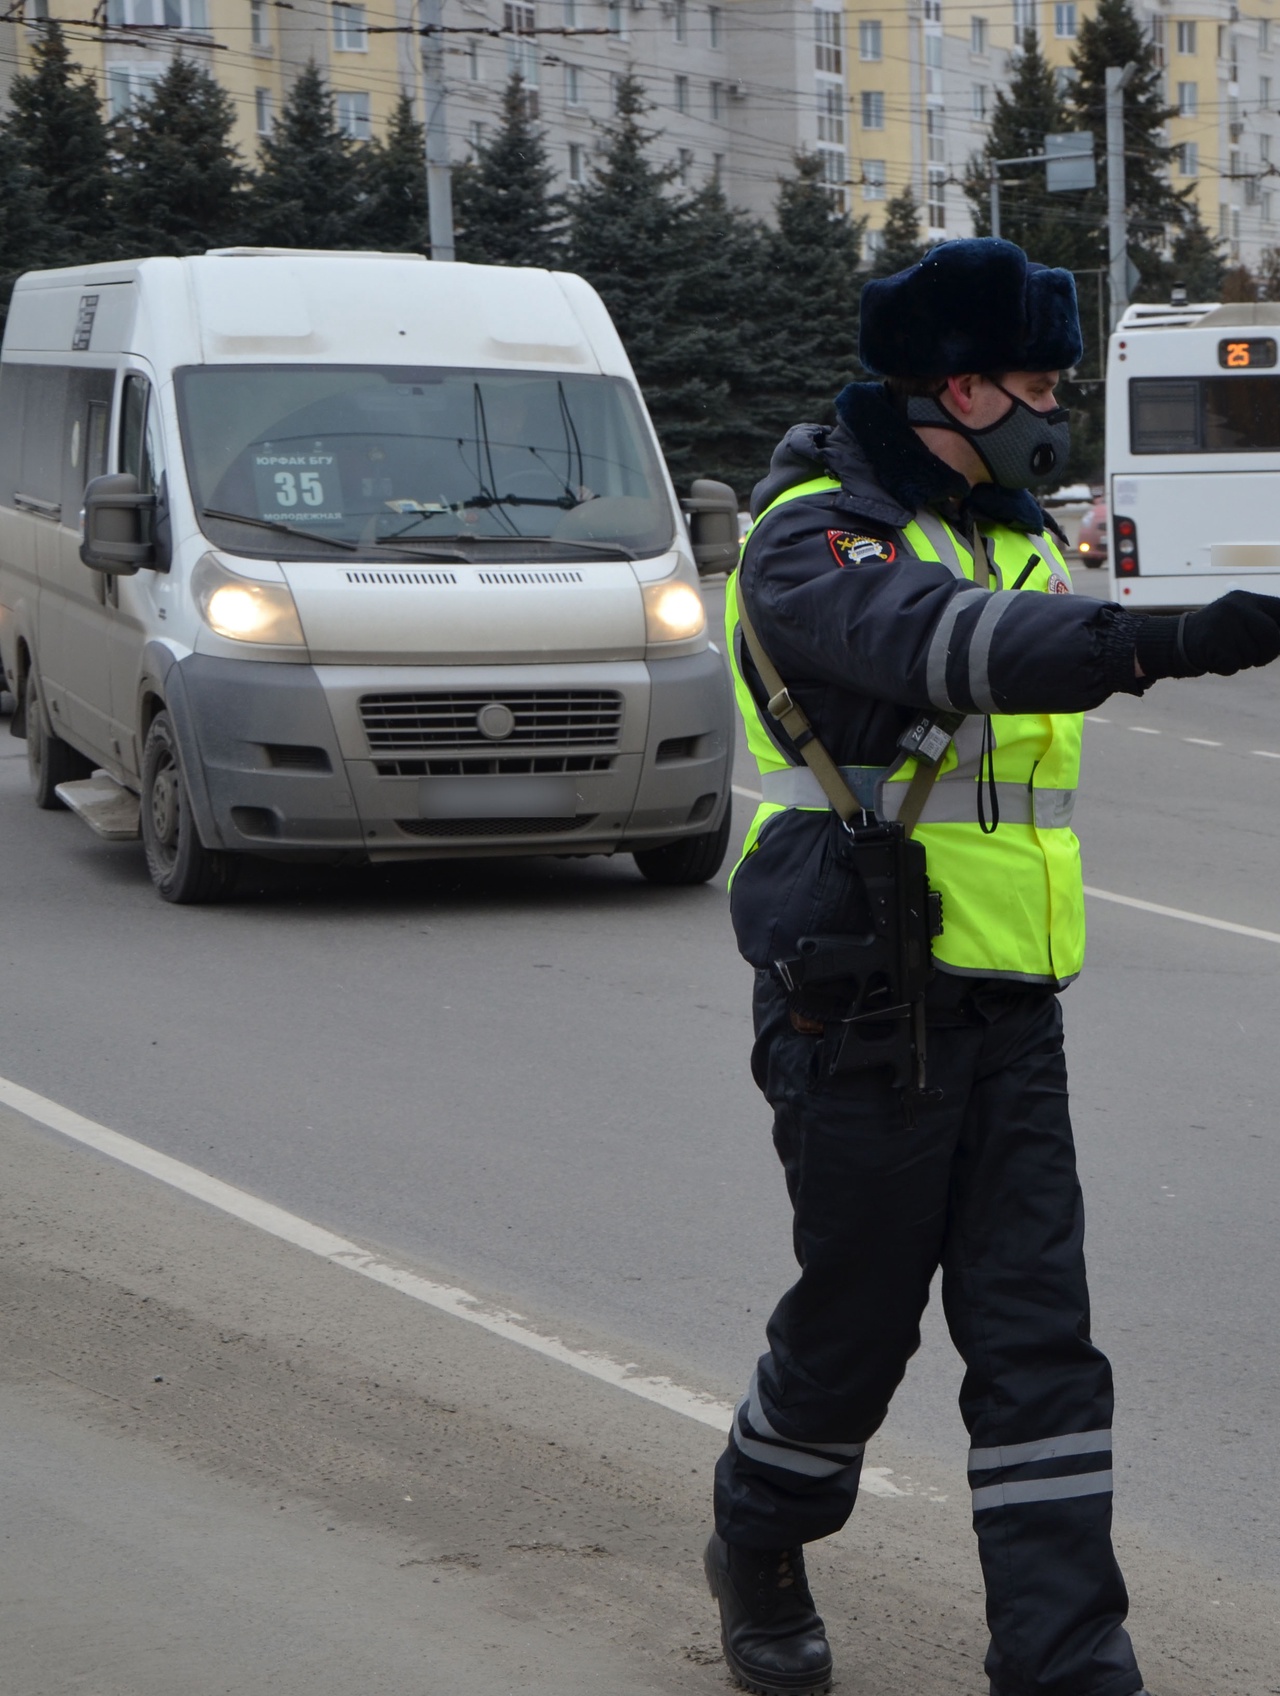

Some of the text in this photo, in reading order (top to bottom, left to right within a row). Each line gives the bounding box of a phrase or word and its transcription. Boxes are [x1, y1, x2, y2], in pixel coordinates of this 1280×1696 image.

[1227, 343, 1249, 367] 25
[256, 456, 333, 466] ЮРФАК БГУ
[274, 472, 324, 506] 35
[264, 512, 342, 521] МОЛОДЕЖНАЯ
